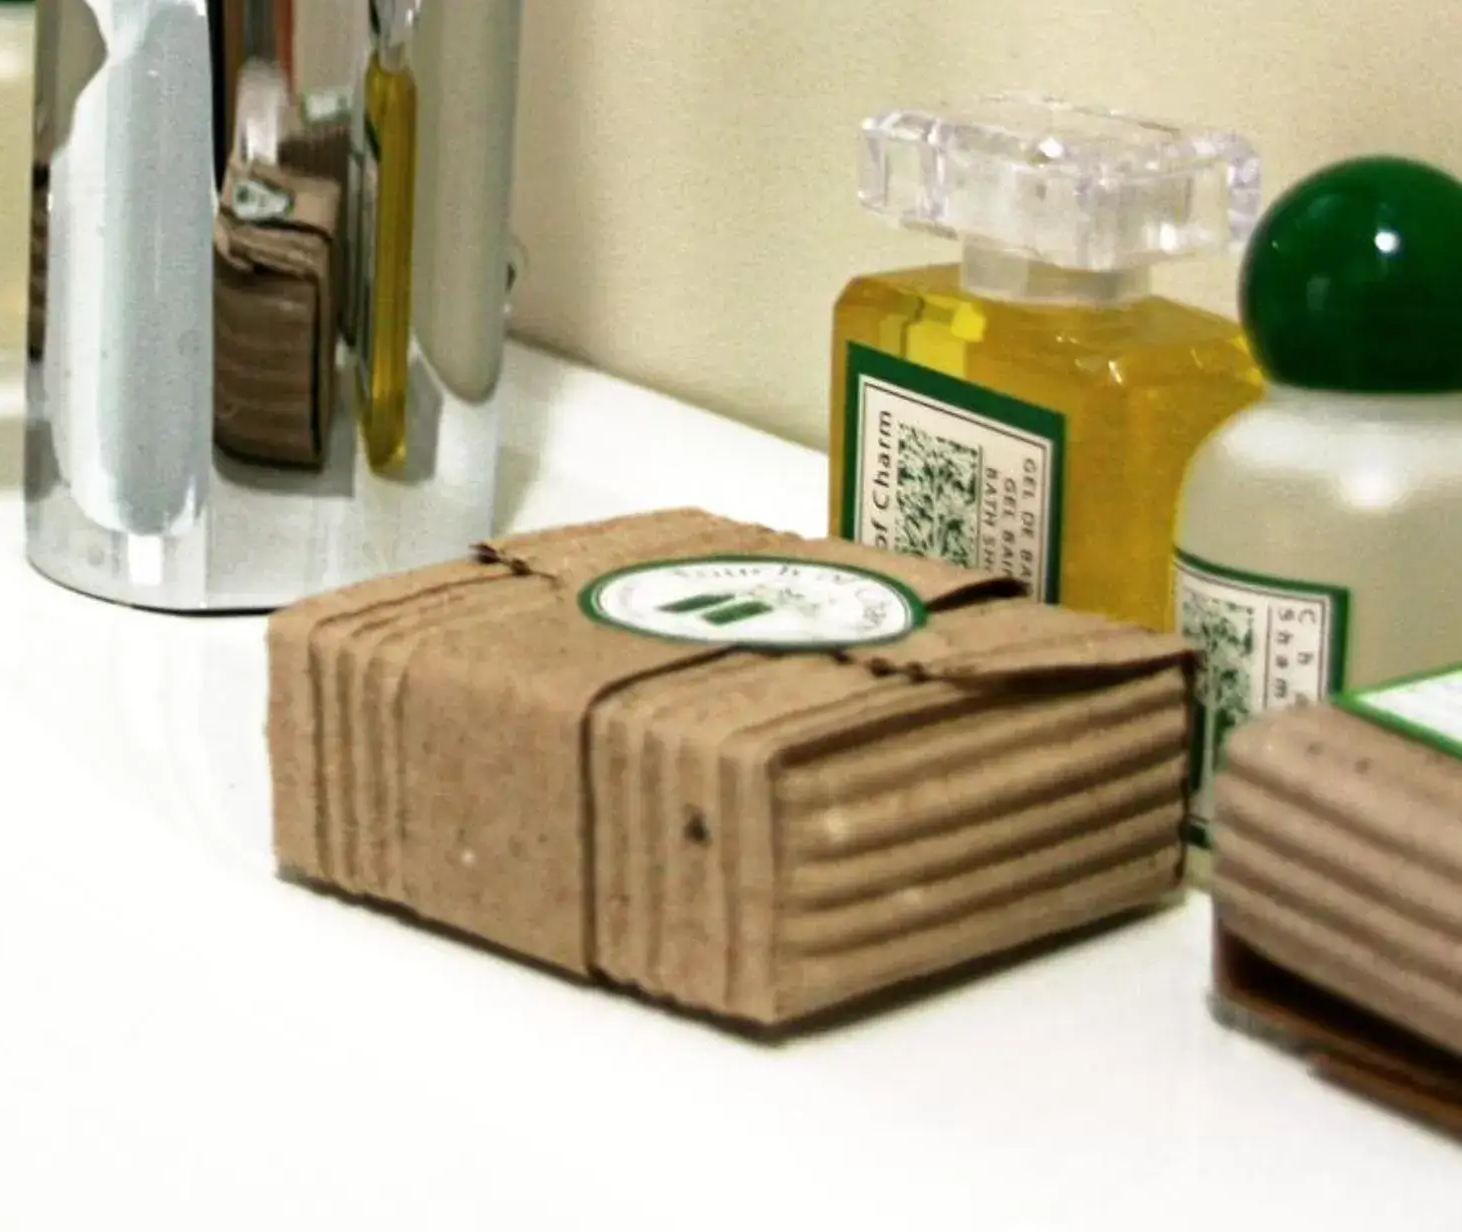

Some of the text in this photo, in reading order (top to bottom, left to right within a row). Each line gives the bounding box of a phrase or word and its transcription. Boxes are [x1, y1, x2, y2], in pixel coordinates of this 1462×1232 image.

[872, 410, 892, 511] Charm
[984, 467, 998, 528] BATH
[1003, 478, 1017, 519] GEL
[1020, 457, 1036, 577] GEL DE BA
[1274, 609, 1295, 700] Sham
